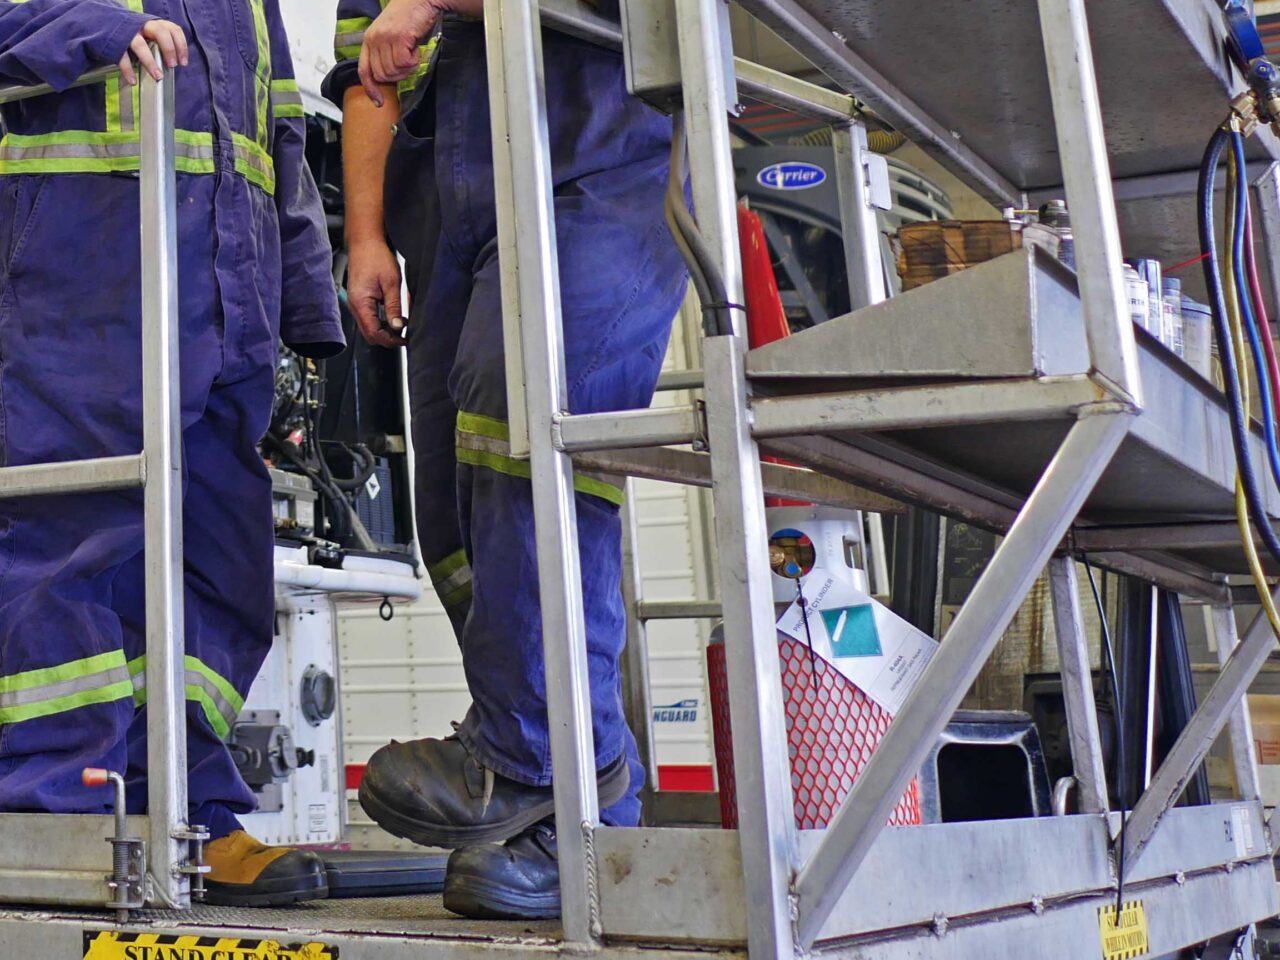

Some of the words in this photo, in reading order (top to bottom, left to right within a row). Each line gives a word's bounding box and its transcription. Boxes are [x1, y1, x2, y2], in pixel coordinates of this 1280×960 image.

[766, 169, 818, 182] Crrier
[793, 606, 814, 633] PROUCT
[810, 577, 835, 609] CYLINDER
[653, 709, 698, 722] NGUARD
